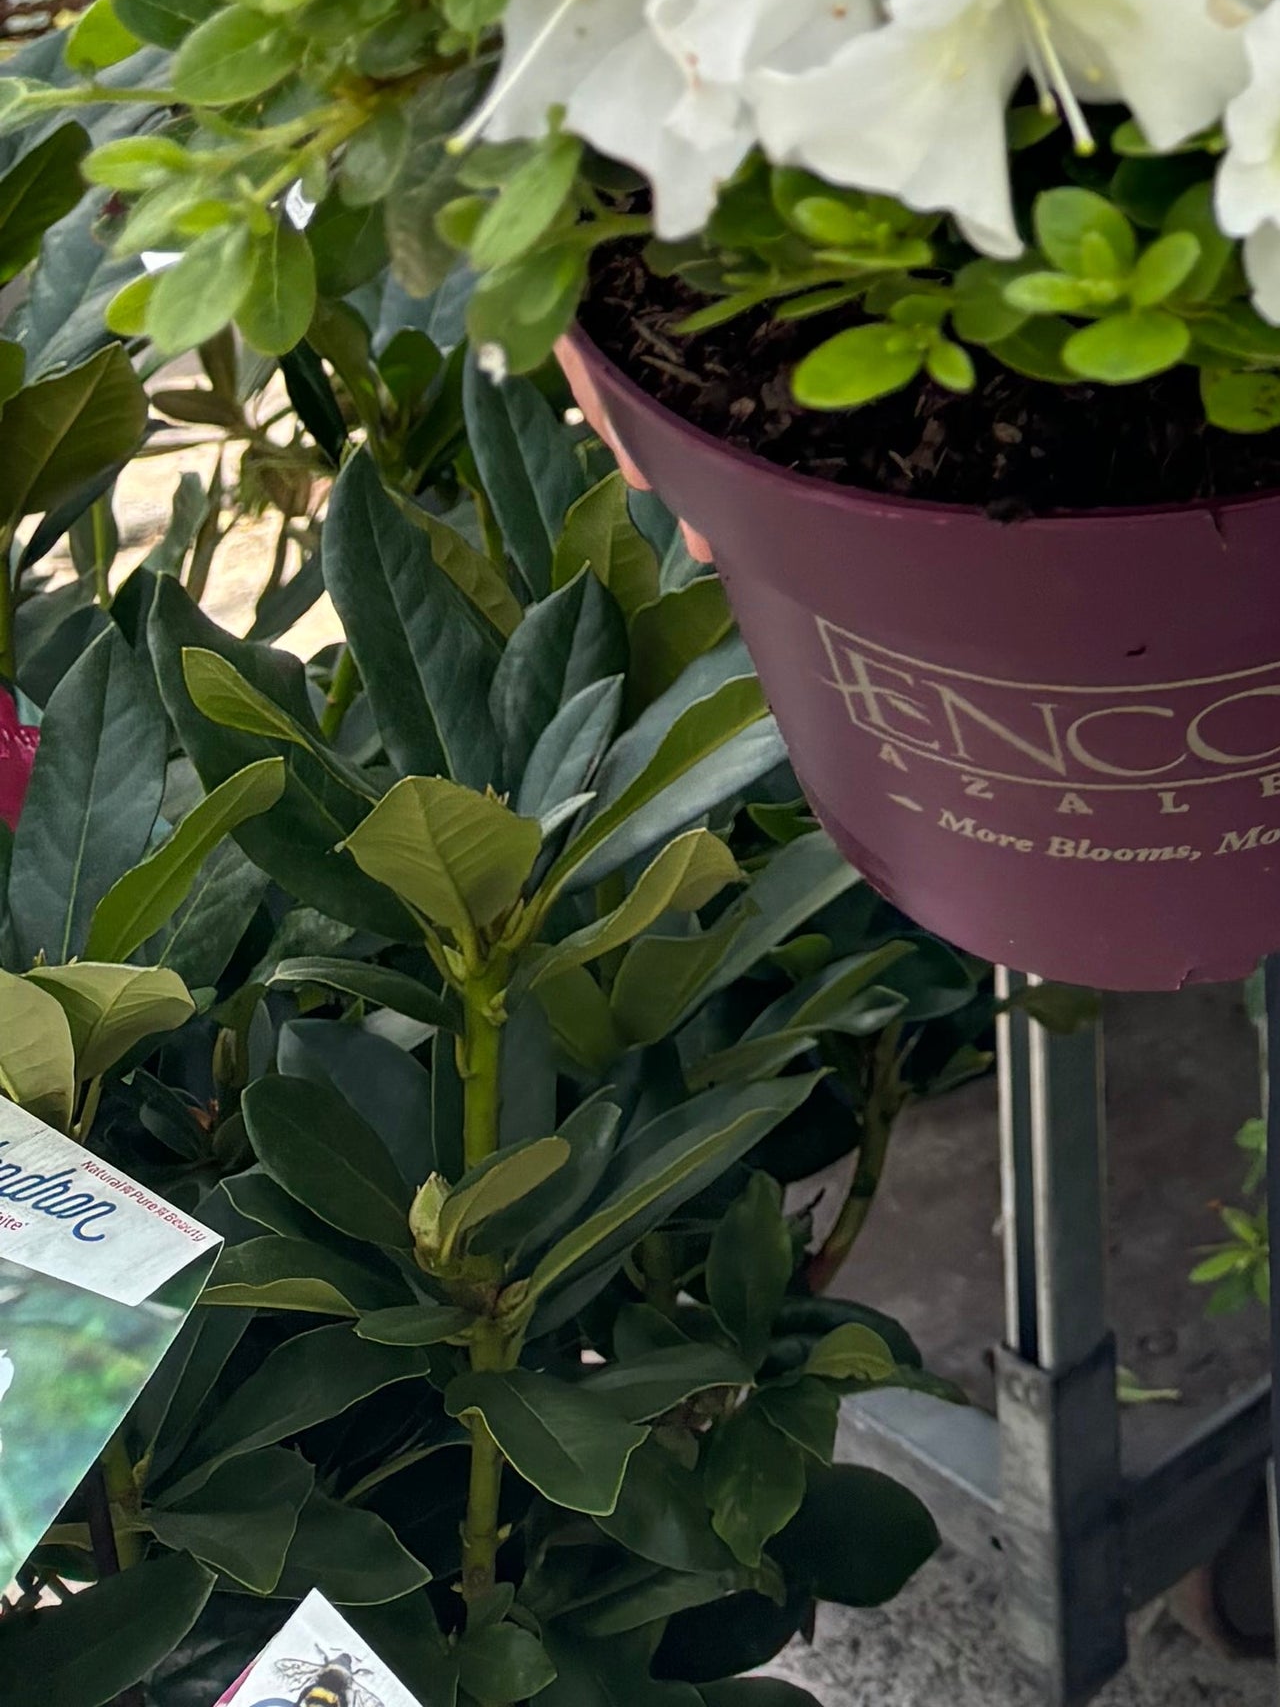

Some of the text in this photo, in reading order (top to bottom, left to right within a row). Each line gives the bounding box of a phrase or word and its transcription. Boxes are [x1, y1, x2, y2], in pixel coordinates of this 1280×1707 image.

[936, 808, 1034, 853] More
[1045, 835, 1201, 862] Blooms,
[80, 1159, 207, 1243] Natural Pure Beauty
